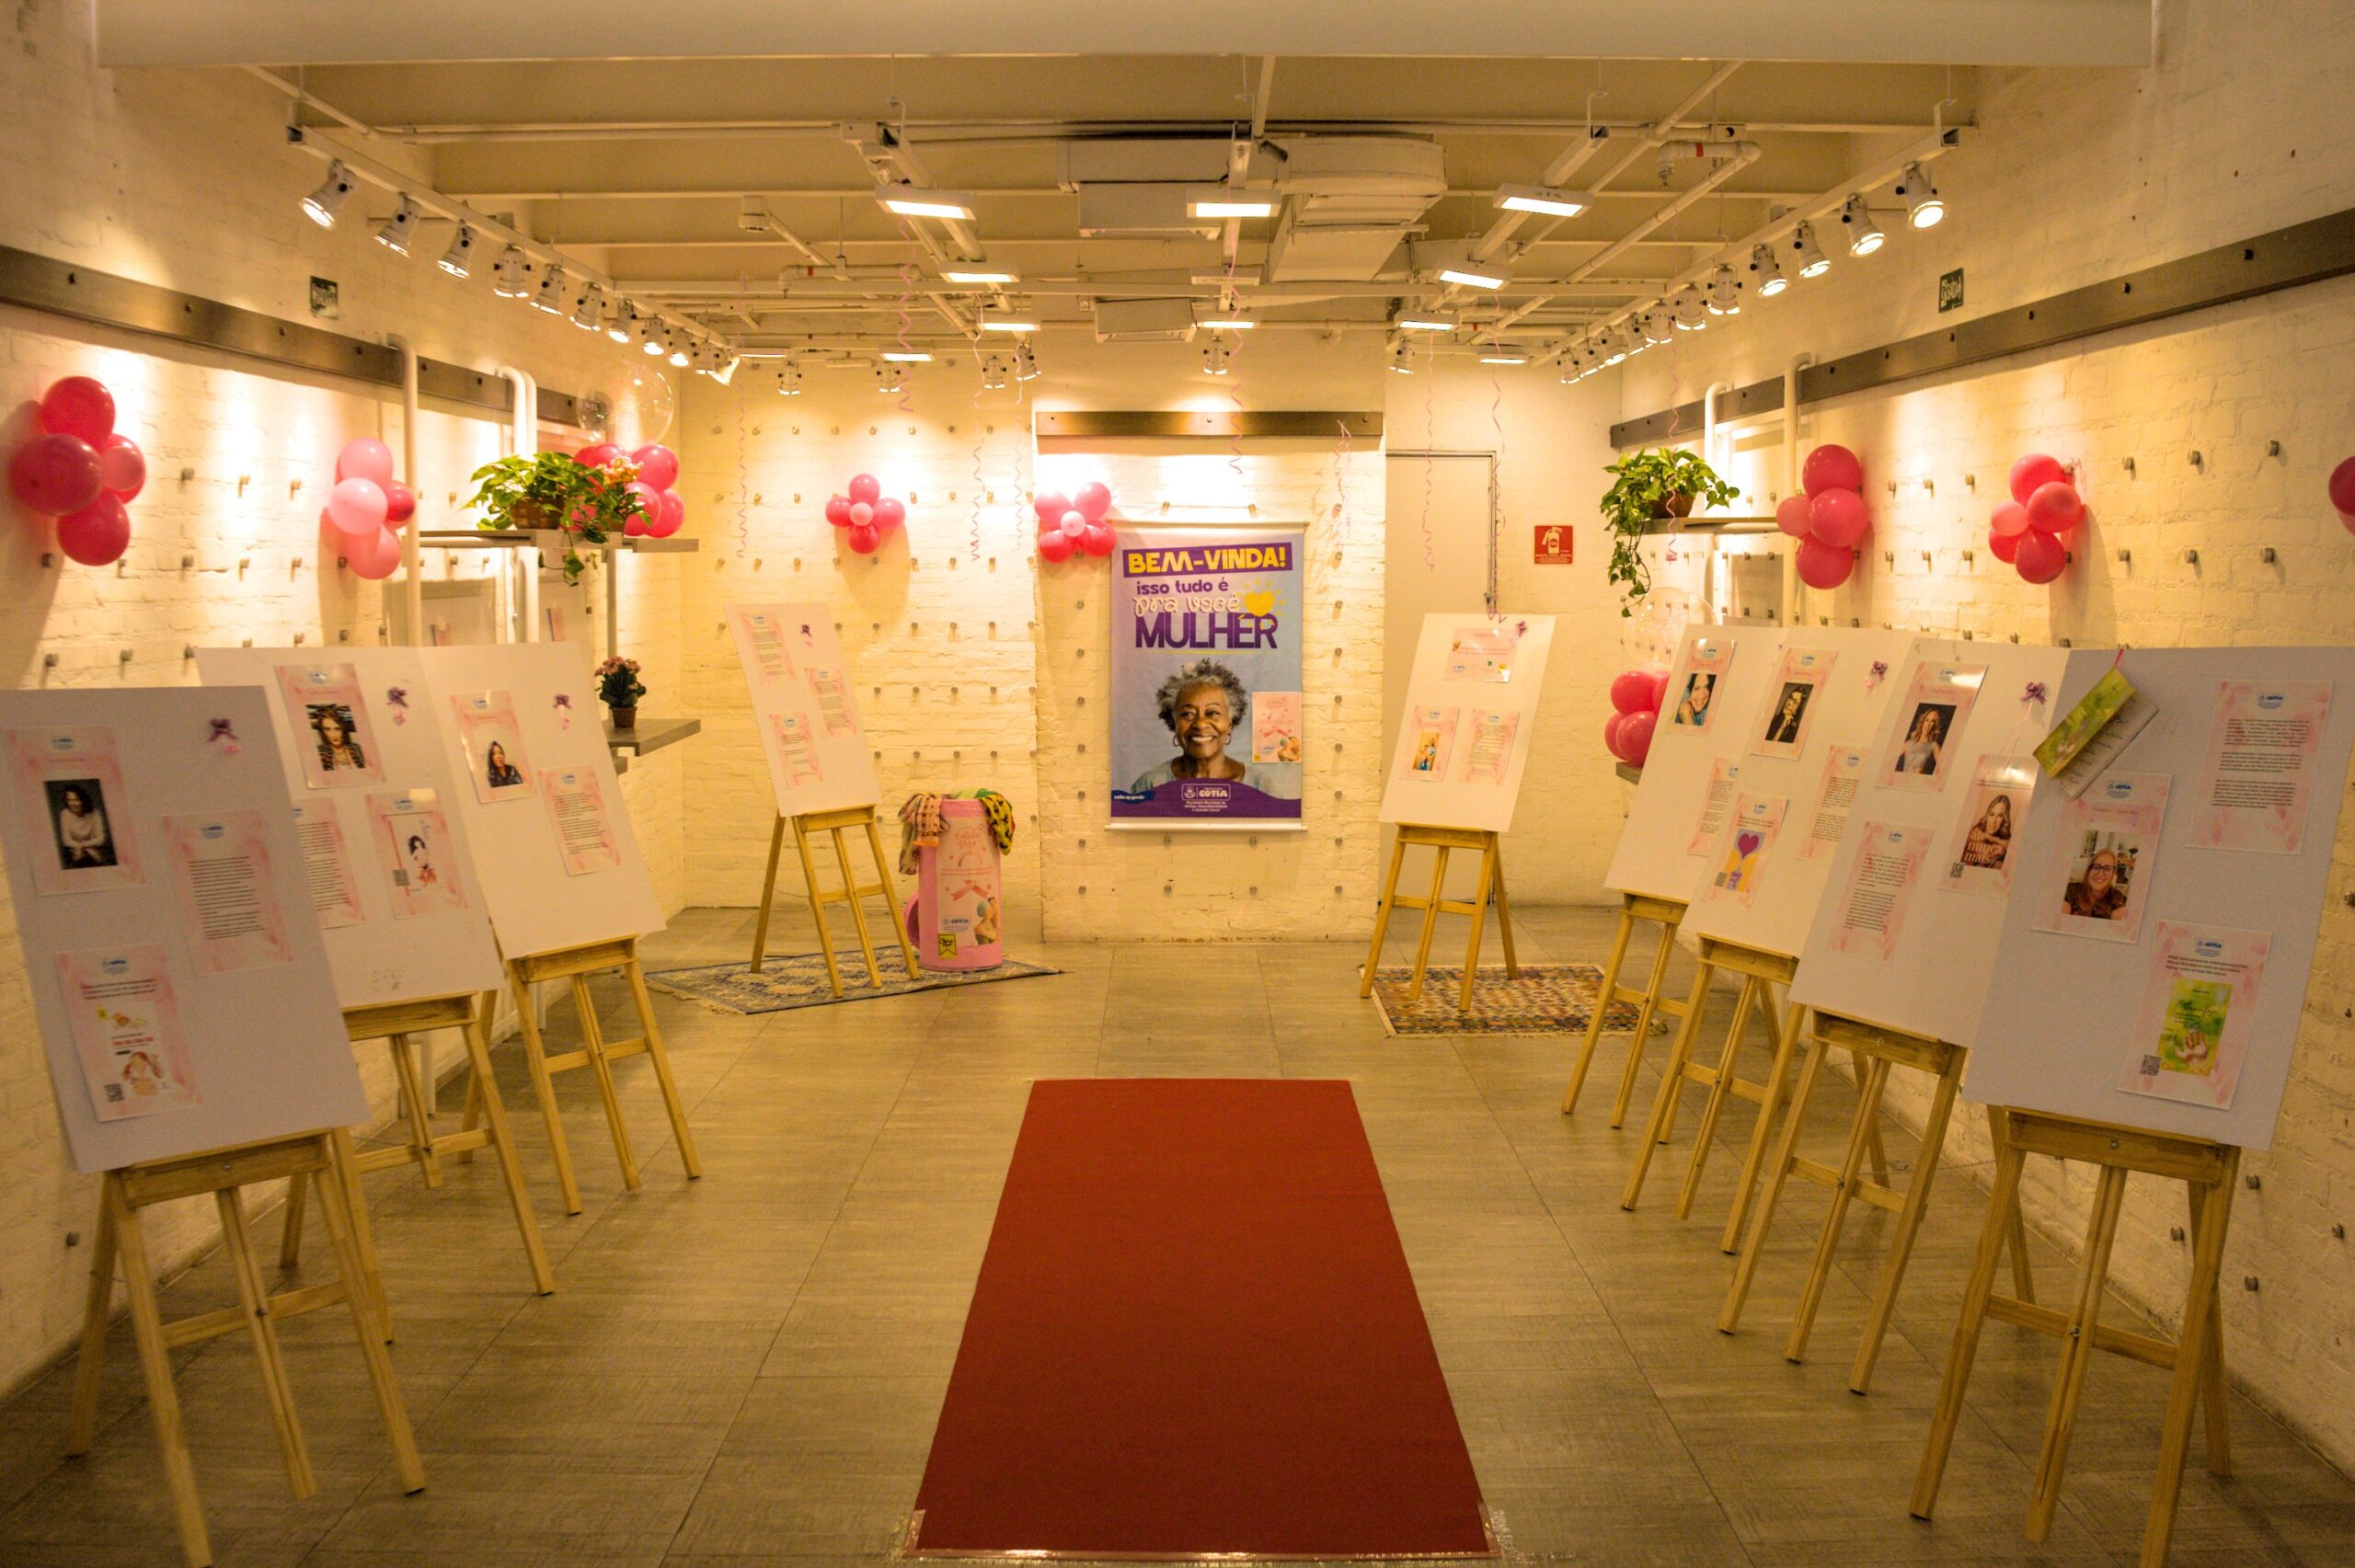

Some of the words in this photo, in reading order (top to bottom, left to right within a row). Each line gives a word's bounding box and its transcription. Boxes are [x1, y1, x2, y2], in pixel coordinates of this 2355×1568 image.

[1128, 547, 1286, 574] BEM-VINDA!
[1136, 581, 1169, 595] isso
[1175, 579, 1212, 593] tudo
[1218, 577, 1229, 591] é
[1132, 597, 1178, 617] pra
[1187, 593, 1242, 613] você
[1135, 612, 1278, 648] MULHER
